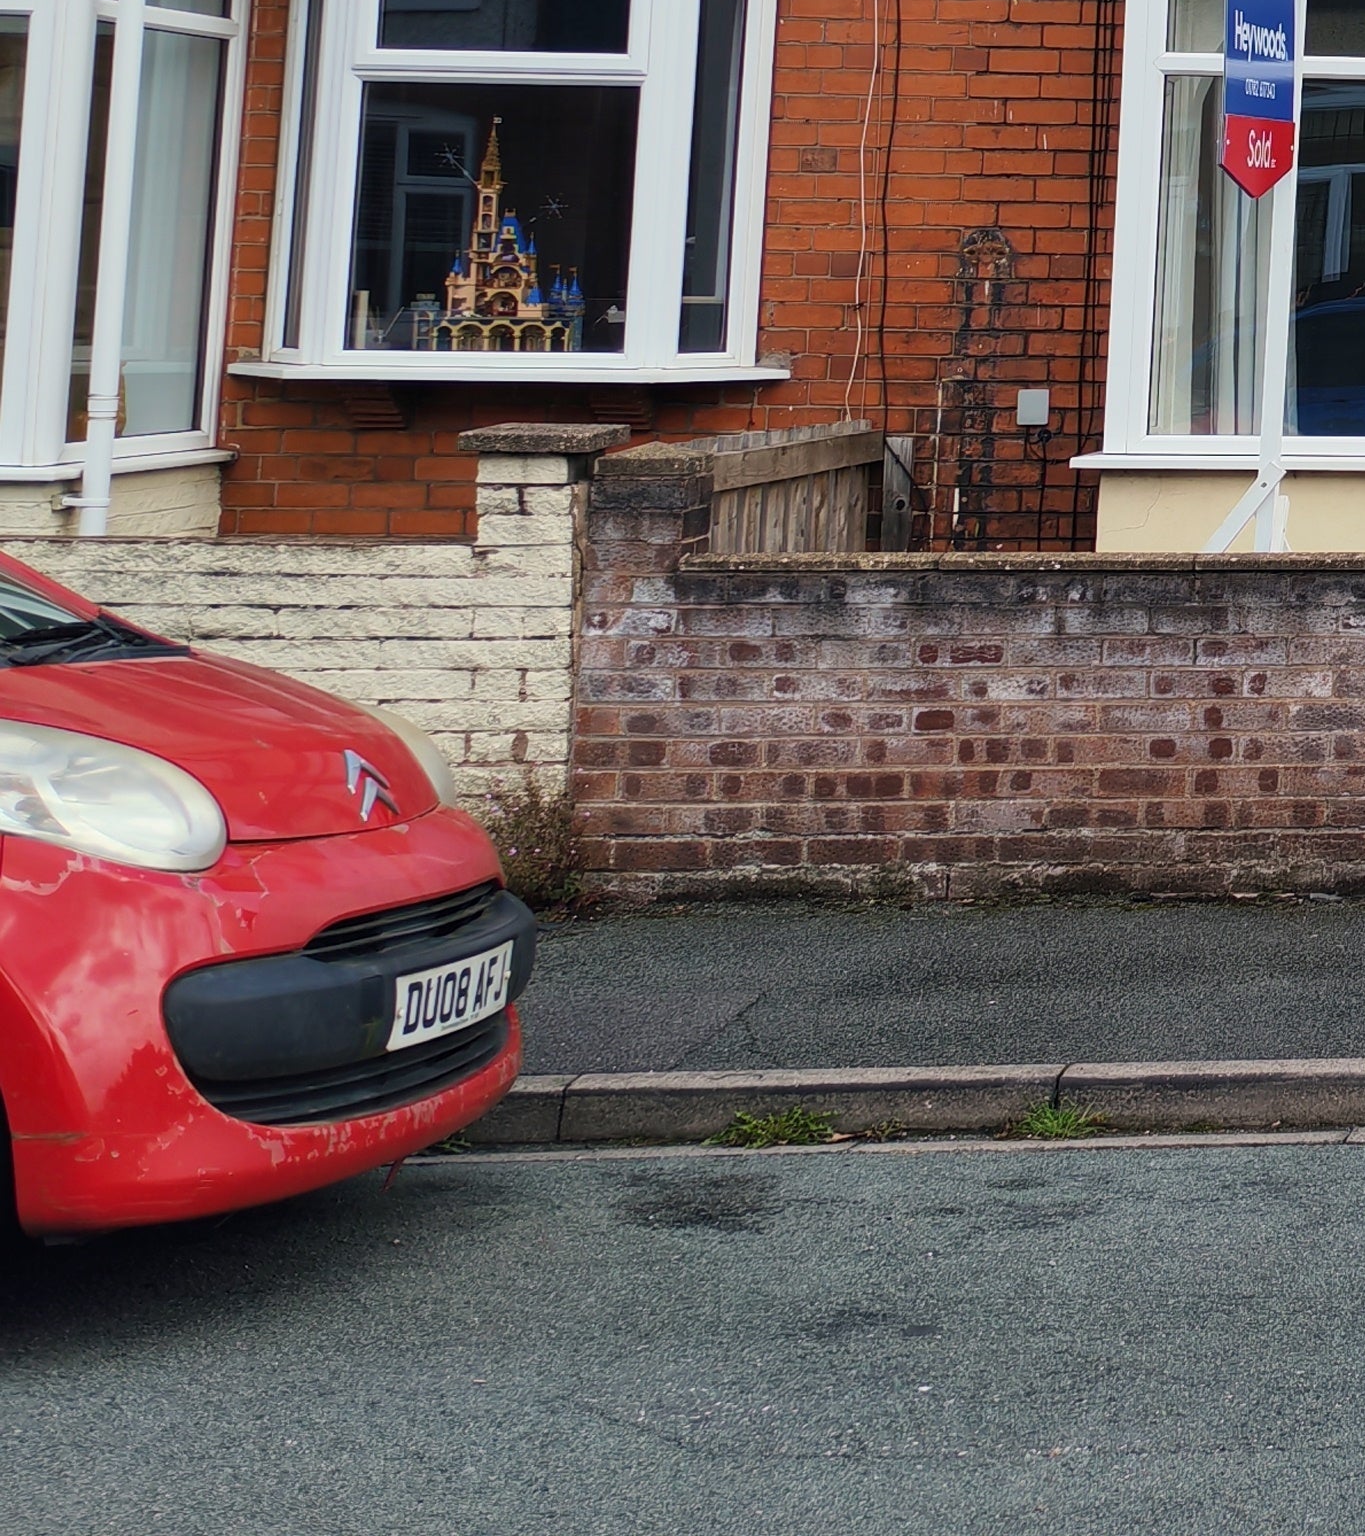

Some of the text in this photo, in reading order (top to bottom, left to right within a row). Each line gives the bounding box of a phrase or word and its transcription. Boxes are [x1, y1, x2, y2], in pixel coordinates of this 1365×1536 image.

[1234, 9, 1286, 62] Heywoods
[1247, 129, 1272, 169] Sold
[402, 950, 507, 1035] DU08 AFJ
